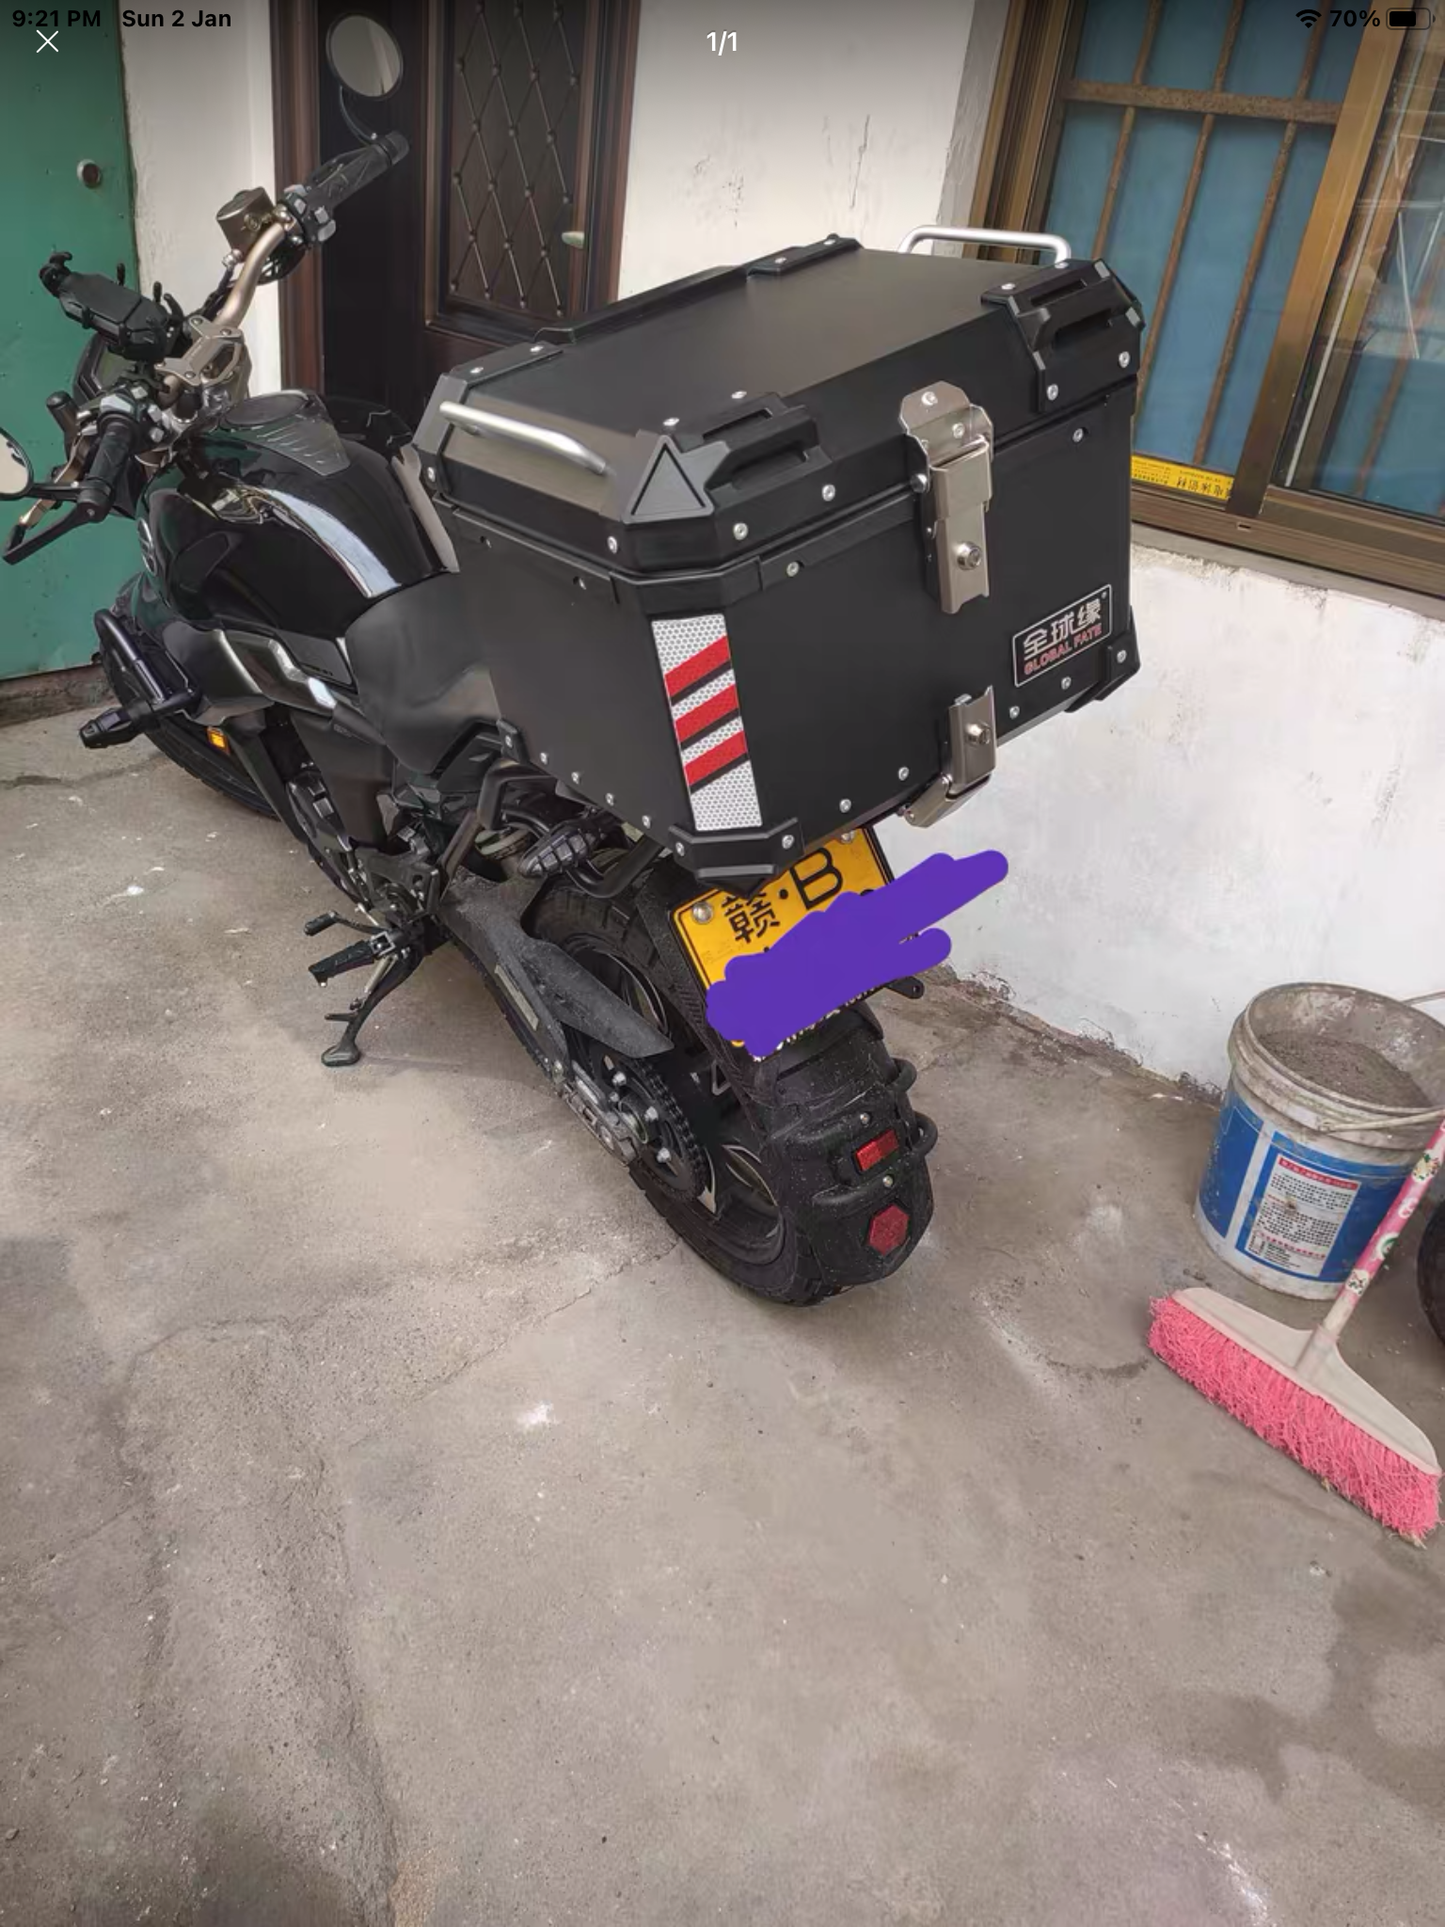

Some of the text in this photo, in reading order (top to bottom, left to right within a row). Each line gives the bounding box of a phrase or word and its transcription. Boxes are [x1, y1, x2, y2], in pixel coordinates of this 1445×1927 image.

[1023, 597, 1101, 661] 全球缘
[1023, 623, 1102, 675] GLOBAL FATE
